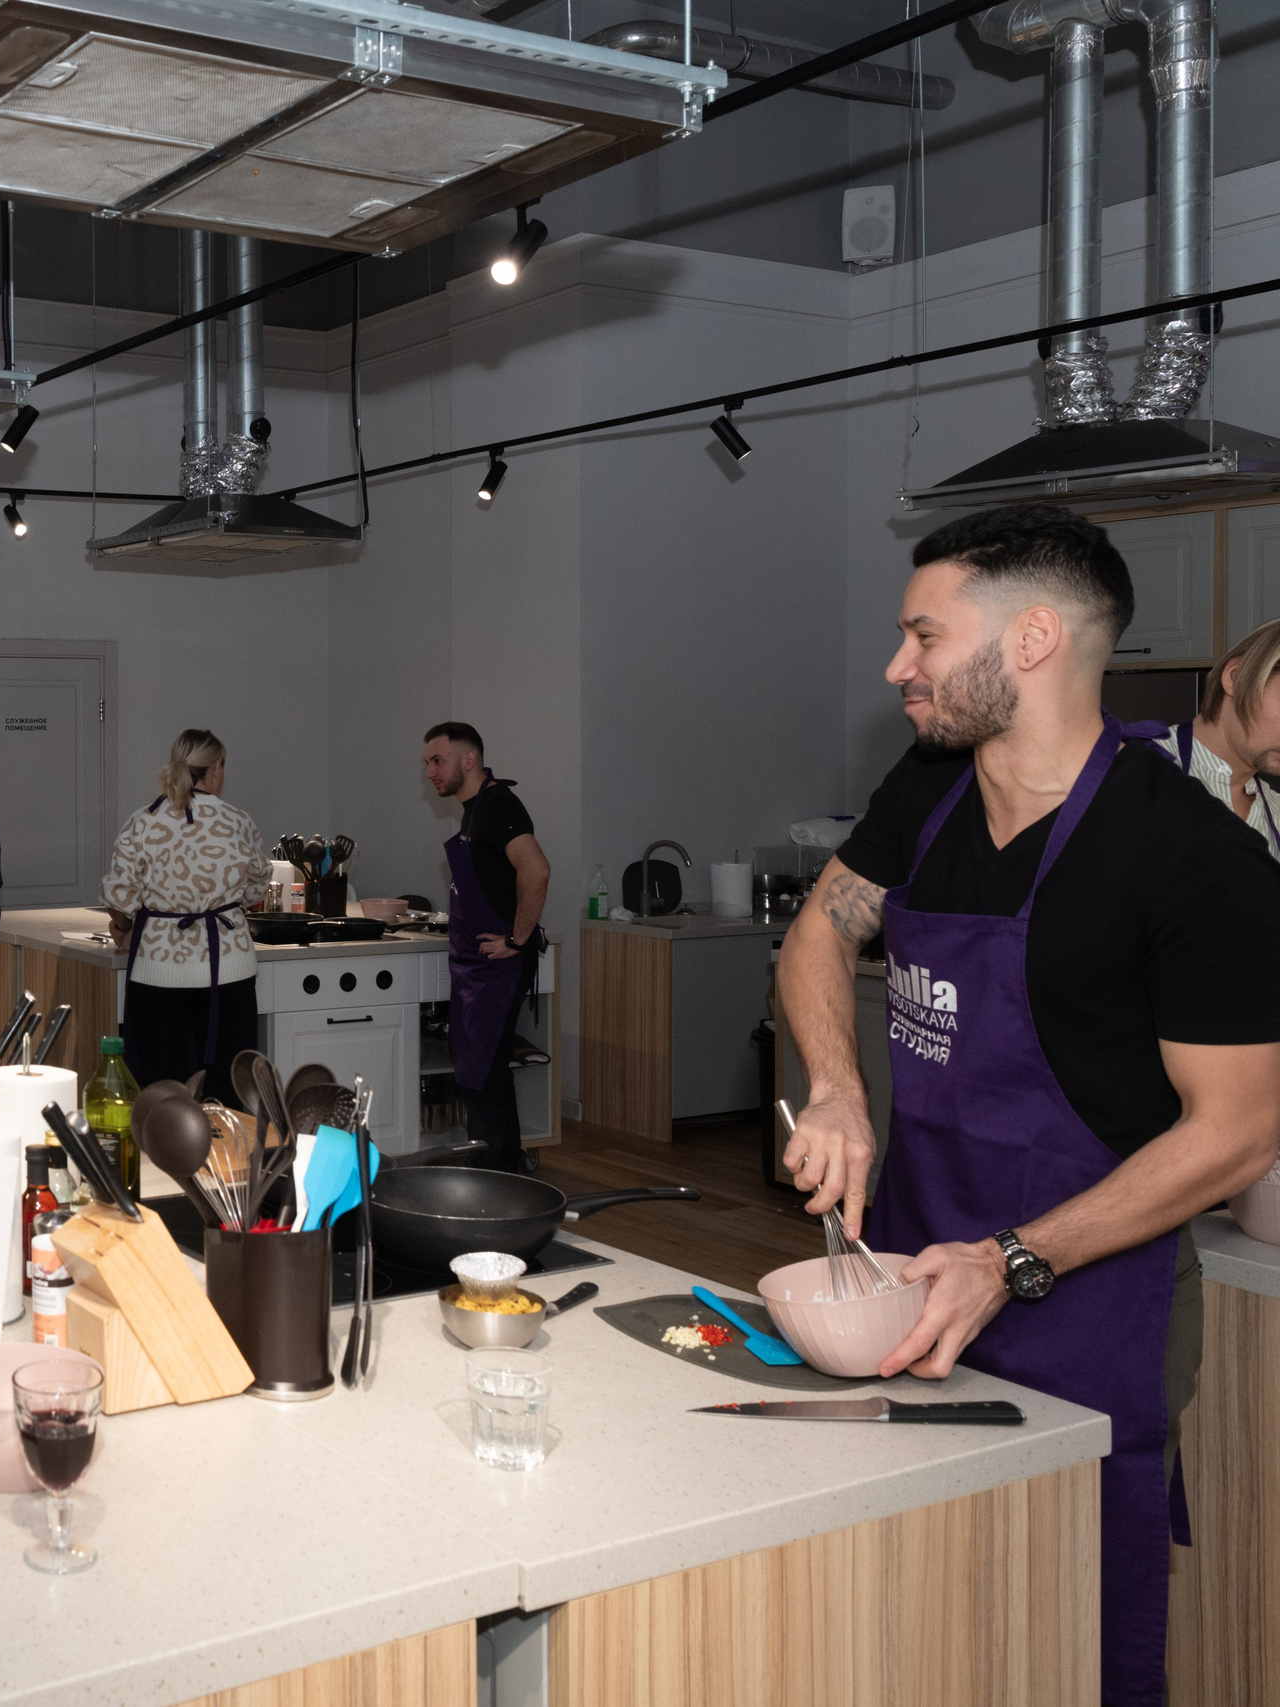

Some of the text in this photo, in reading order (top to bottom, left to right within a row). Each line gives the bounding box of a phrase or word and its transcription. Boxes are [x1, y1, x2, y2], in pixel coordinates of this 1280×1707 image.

[4, 717, 48, 725] СЛУЖЕБНОЕ
[4, 724, 48, 732] ПОМЕЩЕНИЕ
[887, 951, 958, 1013] Julia
[887, 988, 958, 1031] VYSOTSKAYA
[891, 1009, 952, 1047] КУЛИНАРНАЯ
[889, 1021, 951, 1066] СТУДИЯ
